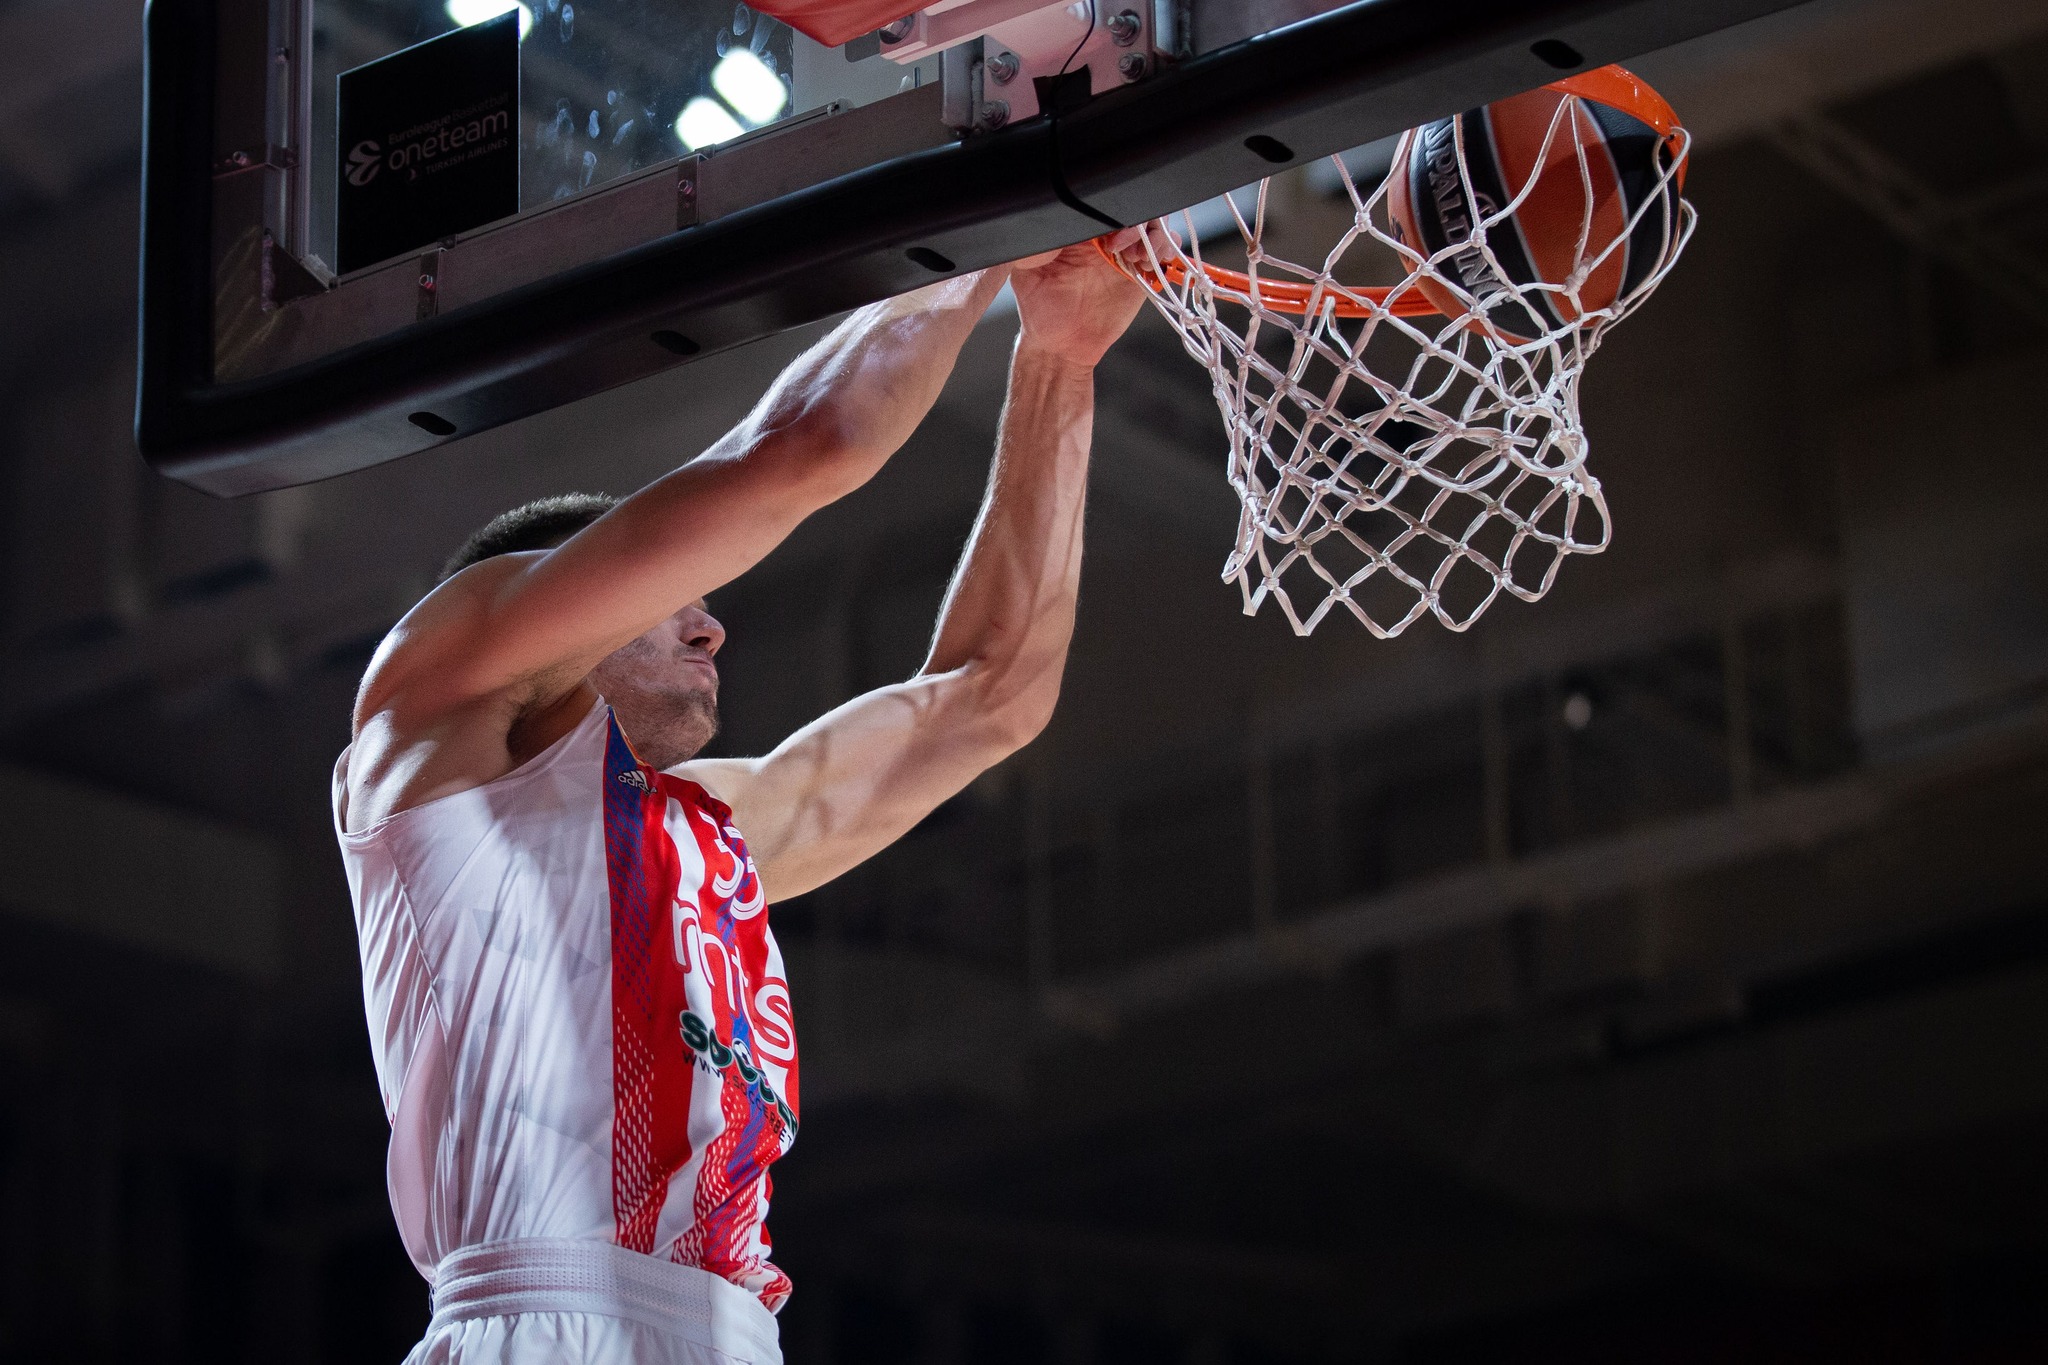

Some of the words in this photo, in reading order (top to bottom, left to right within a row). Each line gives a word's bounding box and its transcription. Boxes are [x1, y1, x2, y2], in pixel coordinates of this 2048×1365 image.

[388, 115, 451, 145] Euroleague
[452, 92, 509, 121] Basketball
[388, 110, 508, 171] oneteam
[425, 153, 465, 175] TURKISH
[467, 137, 508, 160] AIRLINES
[617, 774, 657, 796] adid
